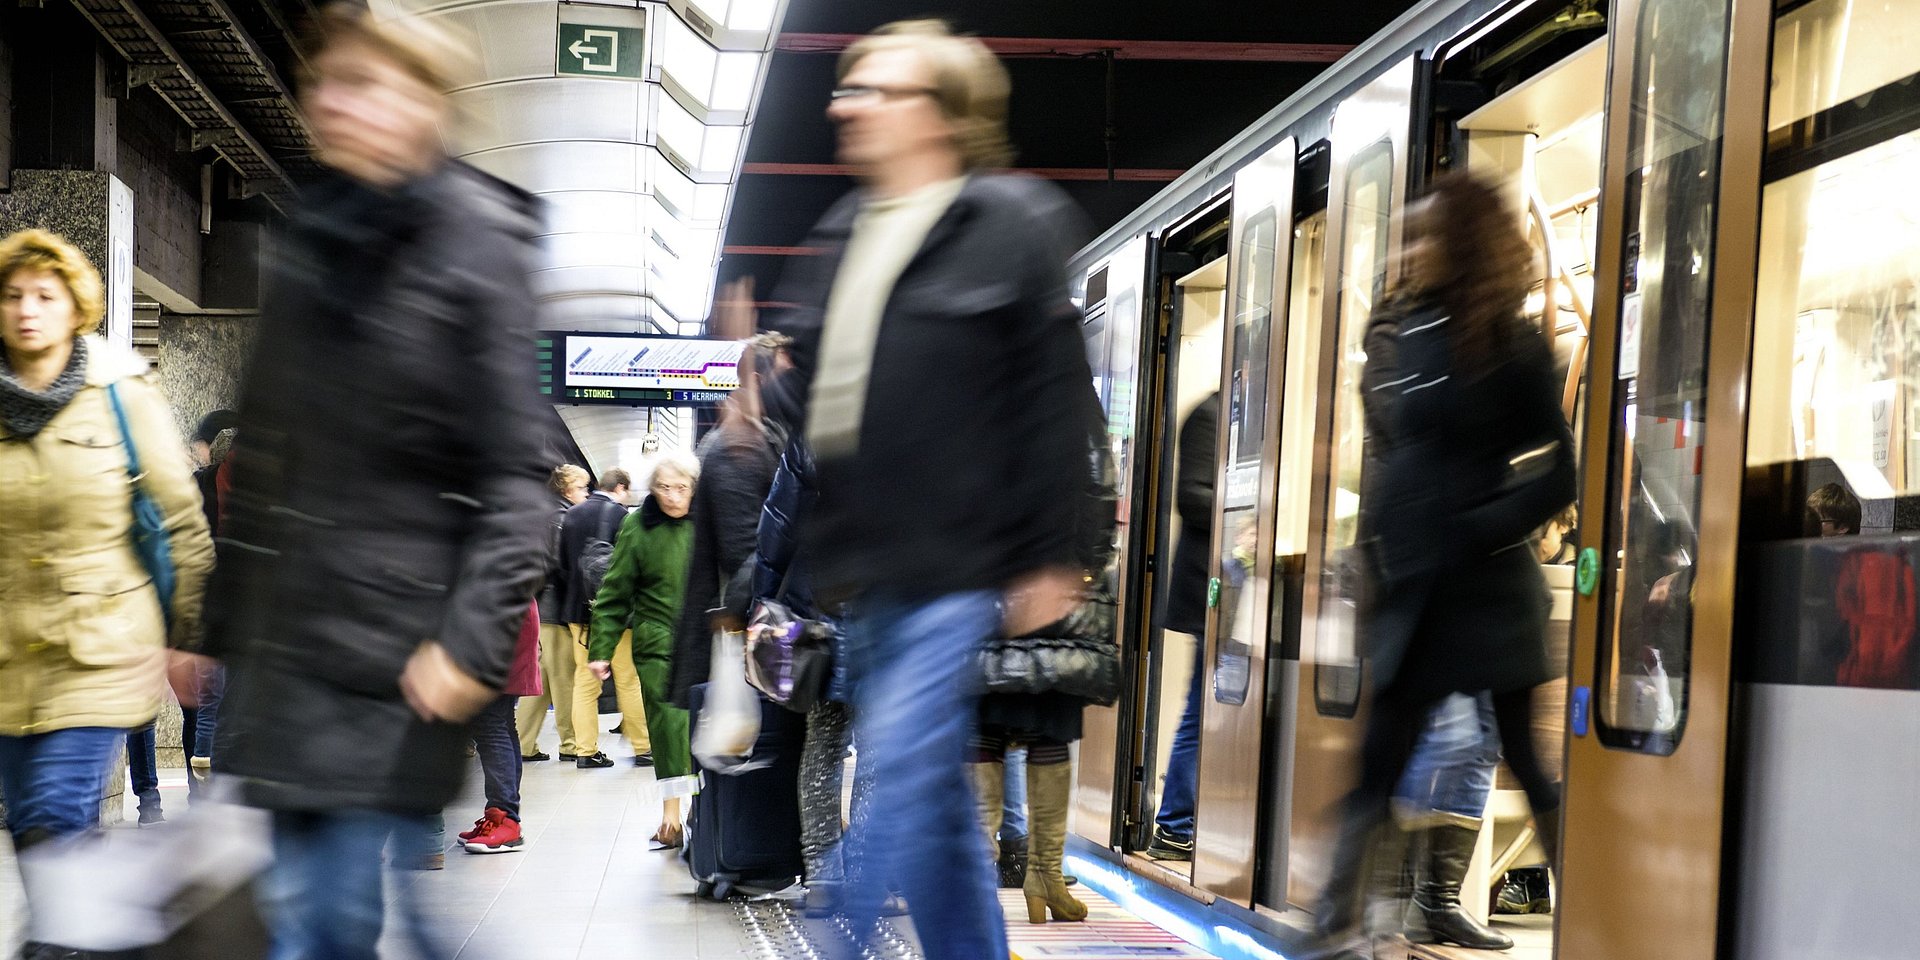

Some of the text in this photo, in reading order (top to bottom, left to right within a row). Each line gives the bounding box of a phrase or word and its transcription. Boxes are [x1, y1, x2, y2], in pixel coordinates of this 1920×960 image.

[575, 389, 672, 400] 1 STOKKEL 3
[683, 391, 688, 400] 5
